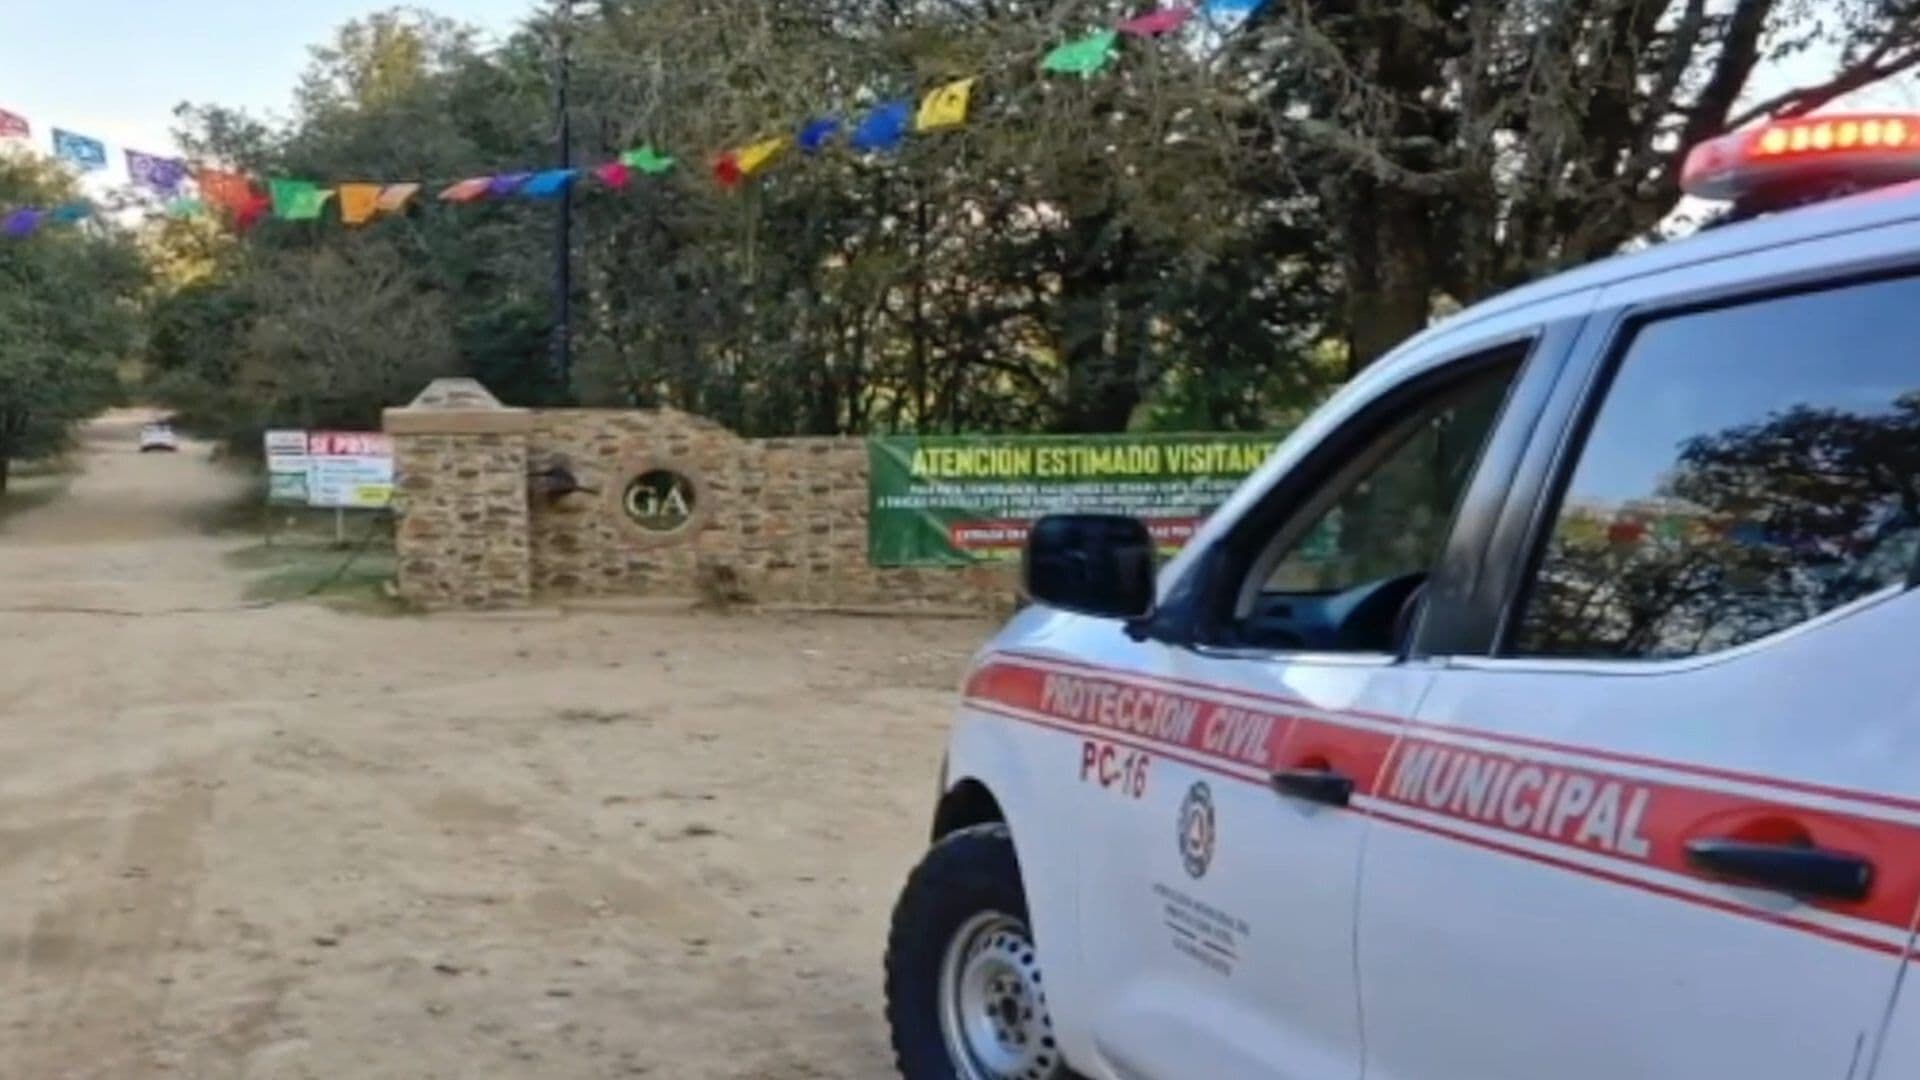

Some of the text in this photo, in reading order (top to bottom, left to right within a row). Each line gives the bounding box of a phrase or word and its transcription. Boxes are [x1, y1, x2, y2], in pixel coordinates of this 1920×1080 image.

[911, 445, 1029, 476] ATENCIÓN
[1036, 446, 1159, 475] ESTIMADO
[627, 481, 689, 518] GA
[1040, 673, 1274, 764] PROTECCION CIVIL
[1079, 740, 1149, 799] PC-16
[1390, 742, 1651, 858] MUNICIPAL
